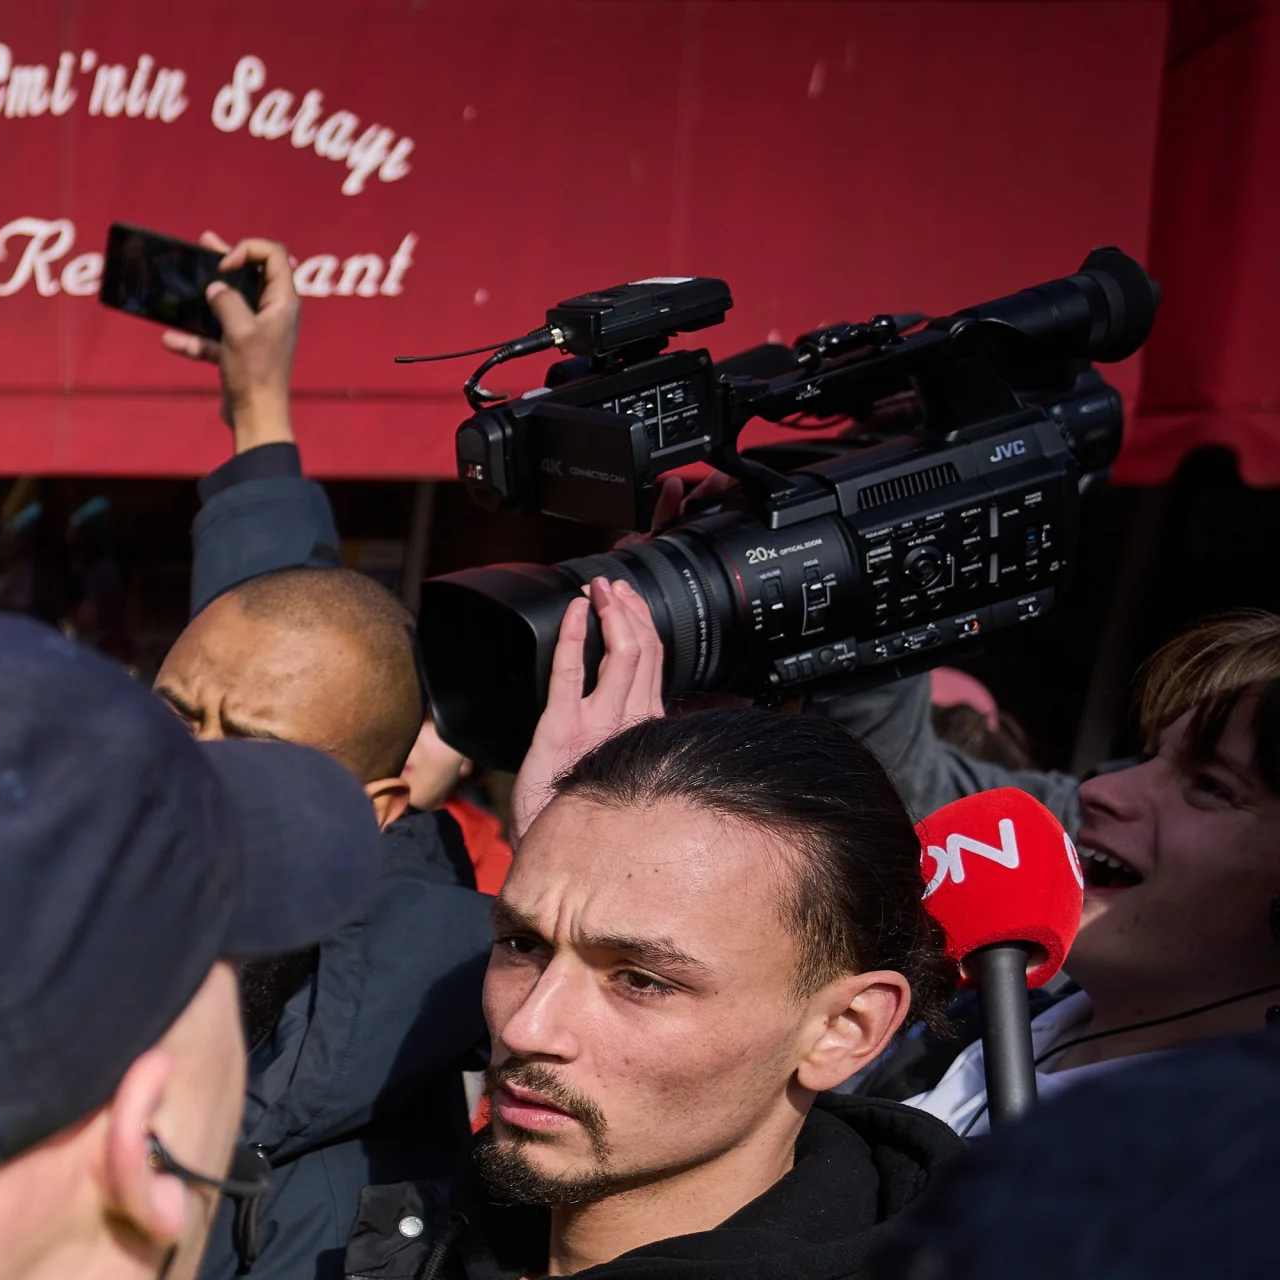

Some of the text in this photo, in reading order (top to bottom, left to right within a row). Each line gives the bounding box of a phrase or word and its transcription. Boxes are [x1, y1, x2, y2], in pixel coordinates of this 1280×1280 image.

[989, 439, 1026, 463] JVC
[539, 457, 563, 477] 4K
[745, 537, 823, 565] 20x OPTICAL ZOOM
